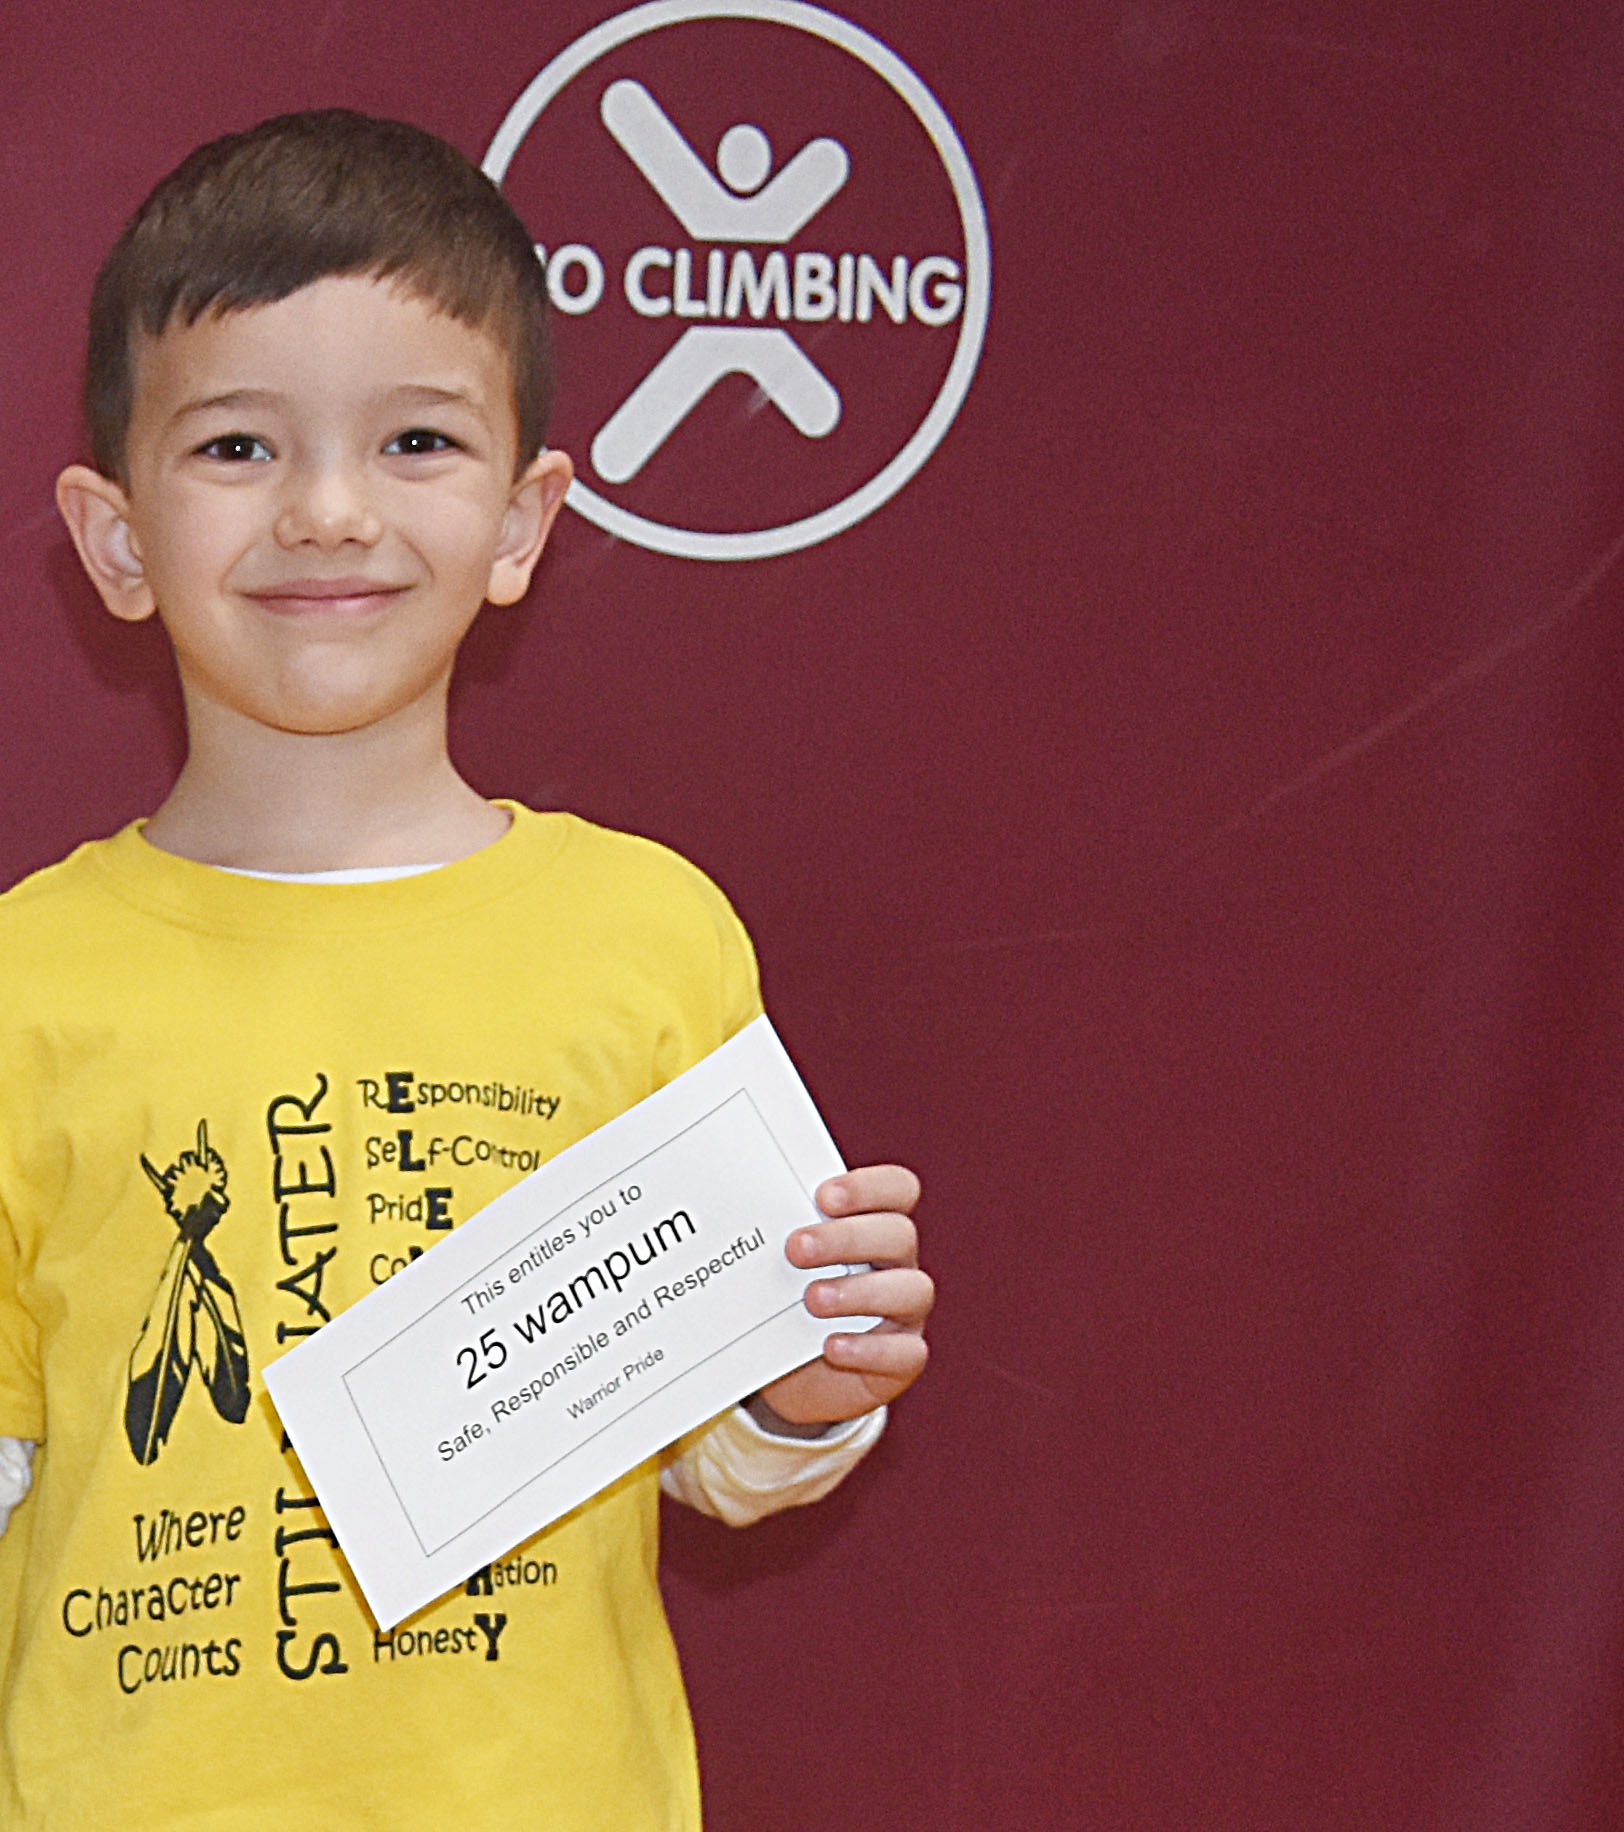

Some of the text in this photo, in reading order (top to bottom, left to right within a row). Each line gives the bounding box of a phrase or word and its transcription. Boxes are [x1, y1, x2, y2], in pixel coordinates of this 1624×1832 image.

[535, 244, 964, 326] O CLIMBING
[367, 1187, 454, 1230] PridE
[460, 1184, 643, 1316] This entitles you to
[456, 1327, 508, 1389] 25
[513, 1209, 697, 1345] wampum
[437, 1227, 766, 1462] Safe, Responsible and Respectful
[566, 1347, 665, 1419] Warrior Pride
[133, 1505, 246, 1563] Where
[62, 1572, 241, 1638] Character
[117, 1637, 243, 1694] Counts
